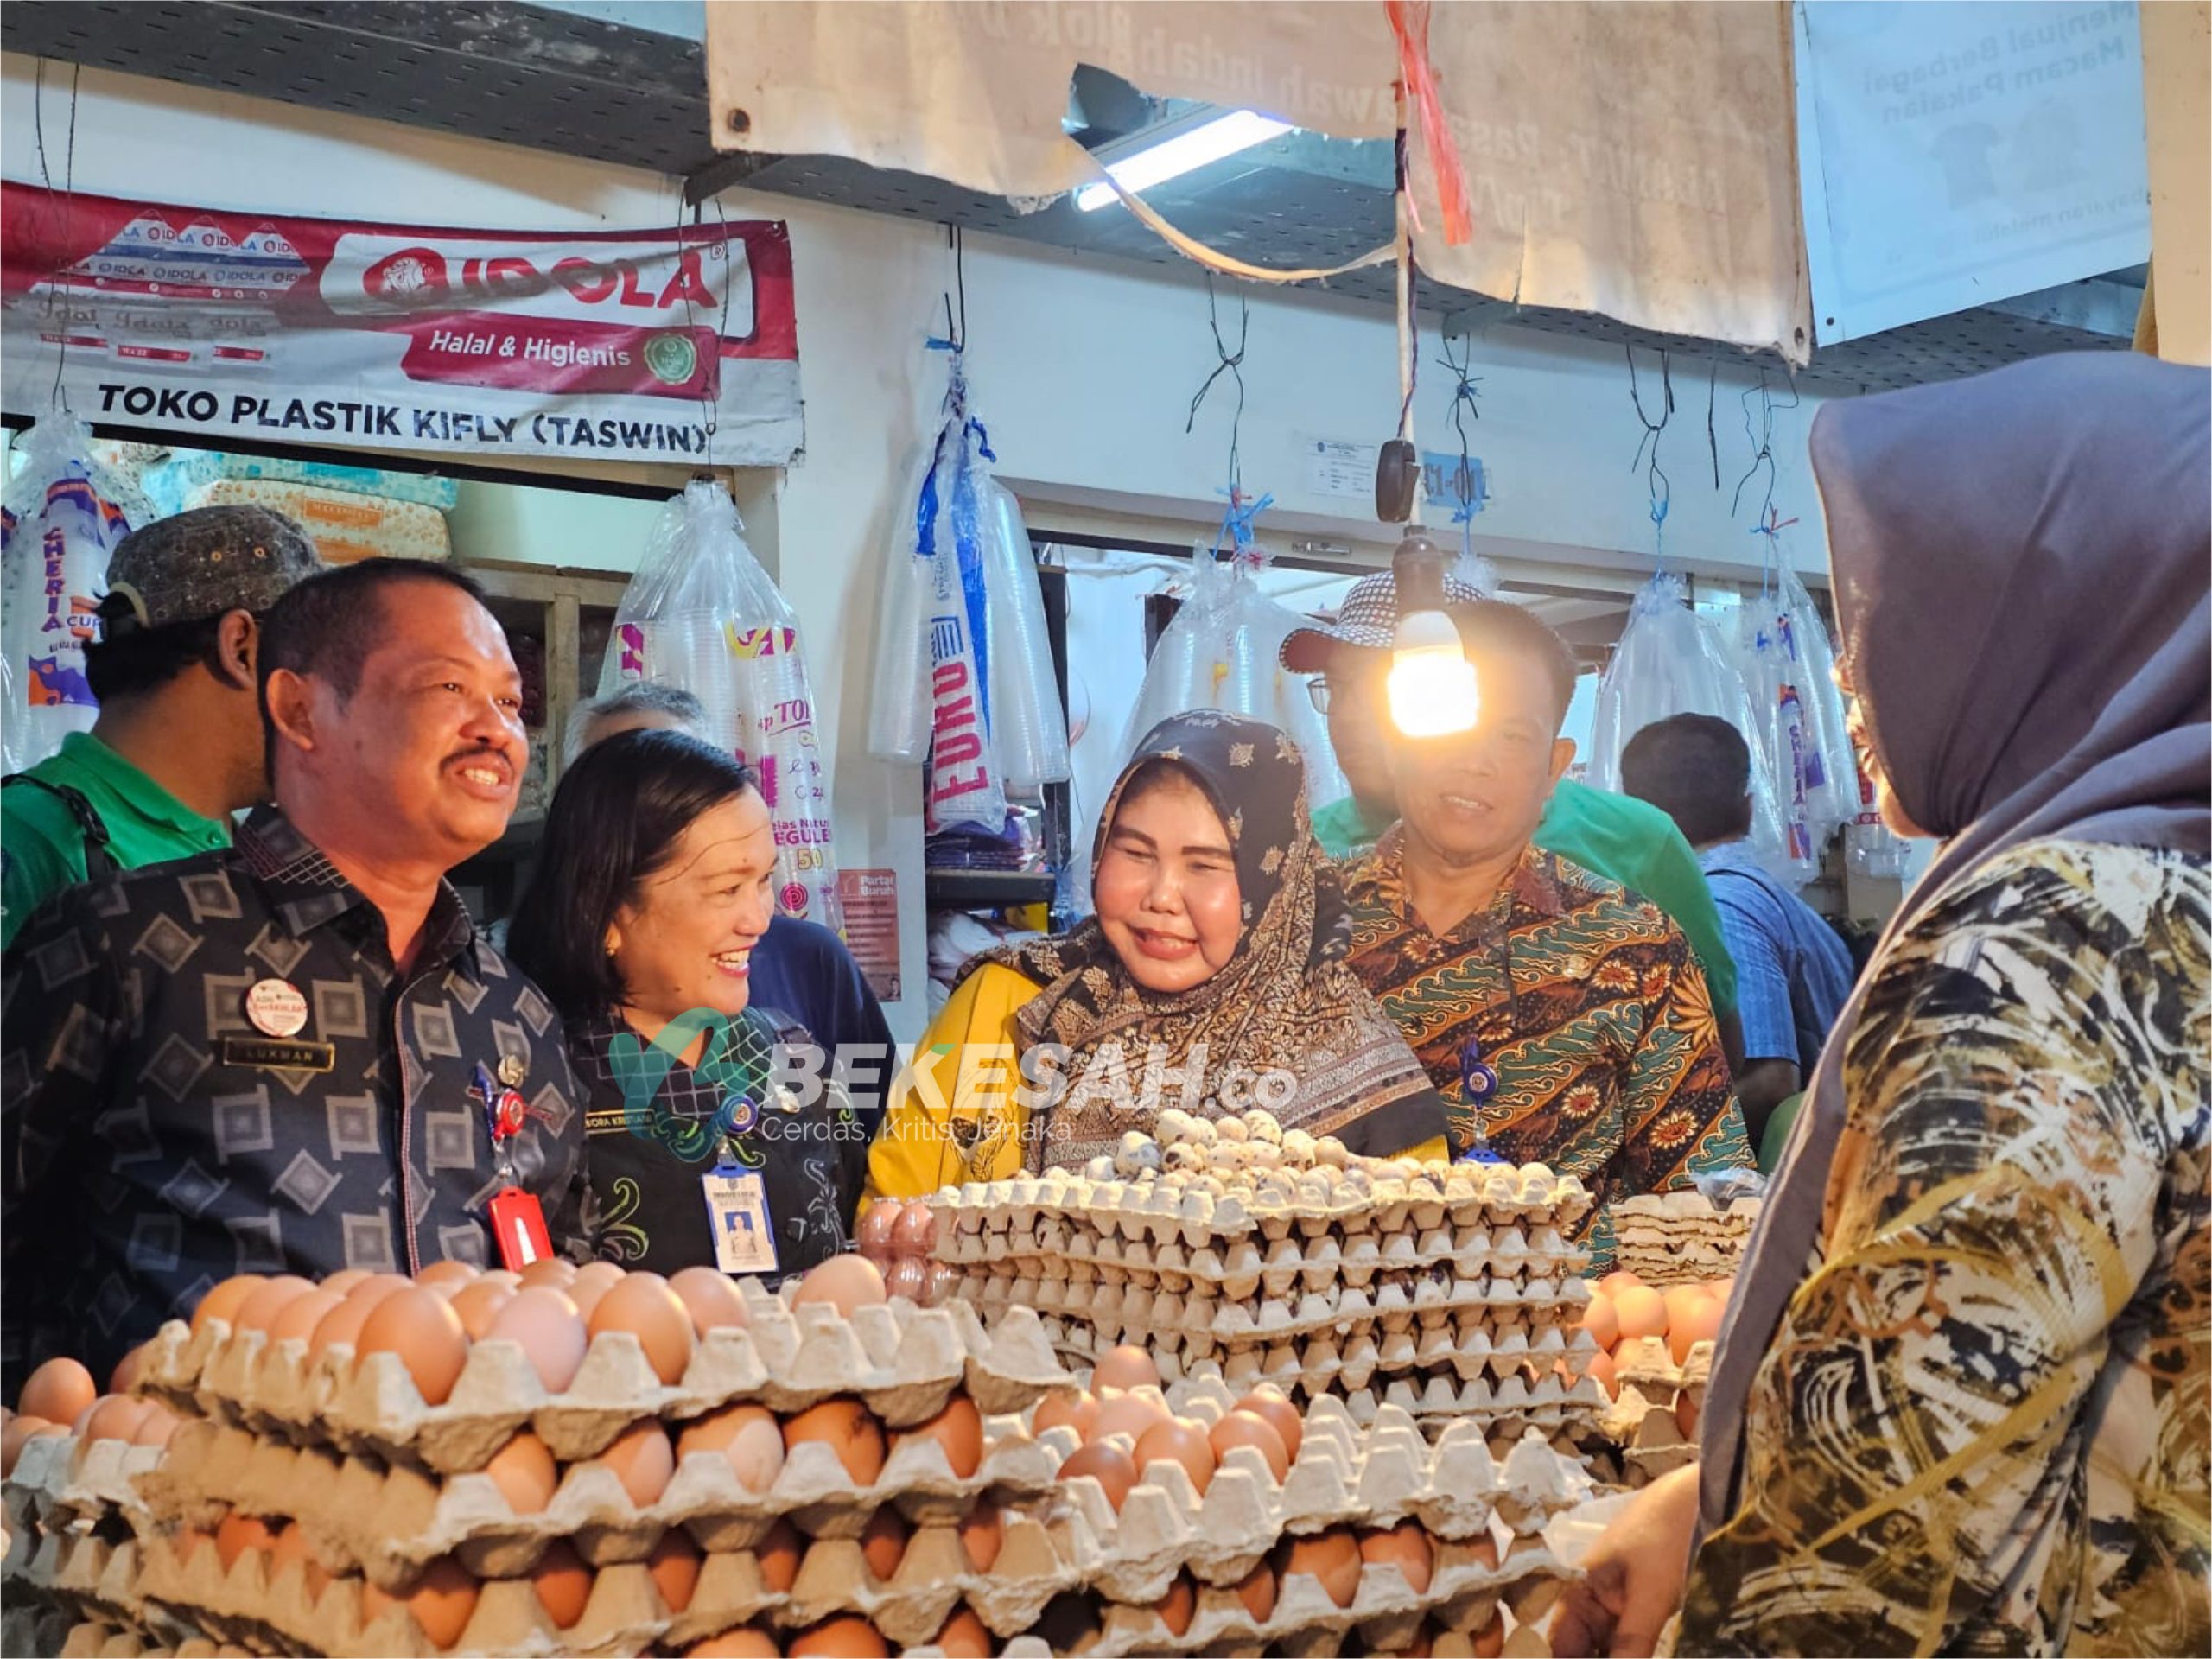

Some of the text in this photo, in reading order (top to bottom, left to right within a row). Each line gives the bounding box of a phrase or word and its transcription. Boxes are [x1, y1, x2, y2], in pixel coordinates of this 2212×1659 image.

[462, 249, 719, 309] IDOLA
[429, 330, 632, 369] Halal & Higienis
[99, 384, 706, 454] TOKO PLASTIK KIFLY (TASWIN)
[774, 828, 830, 846] EGULE
